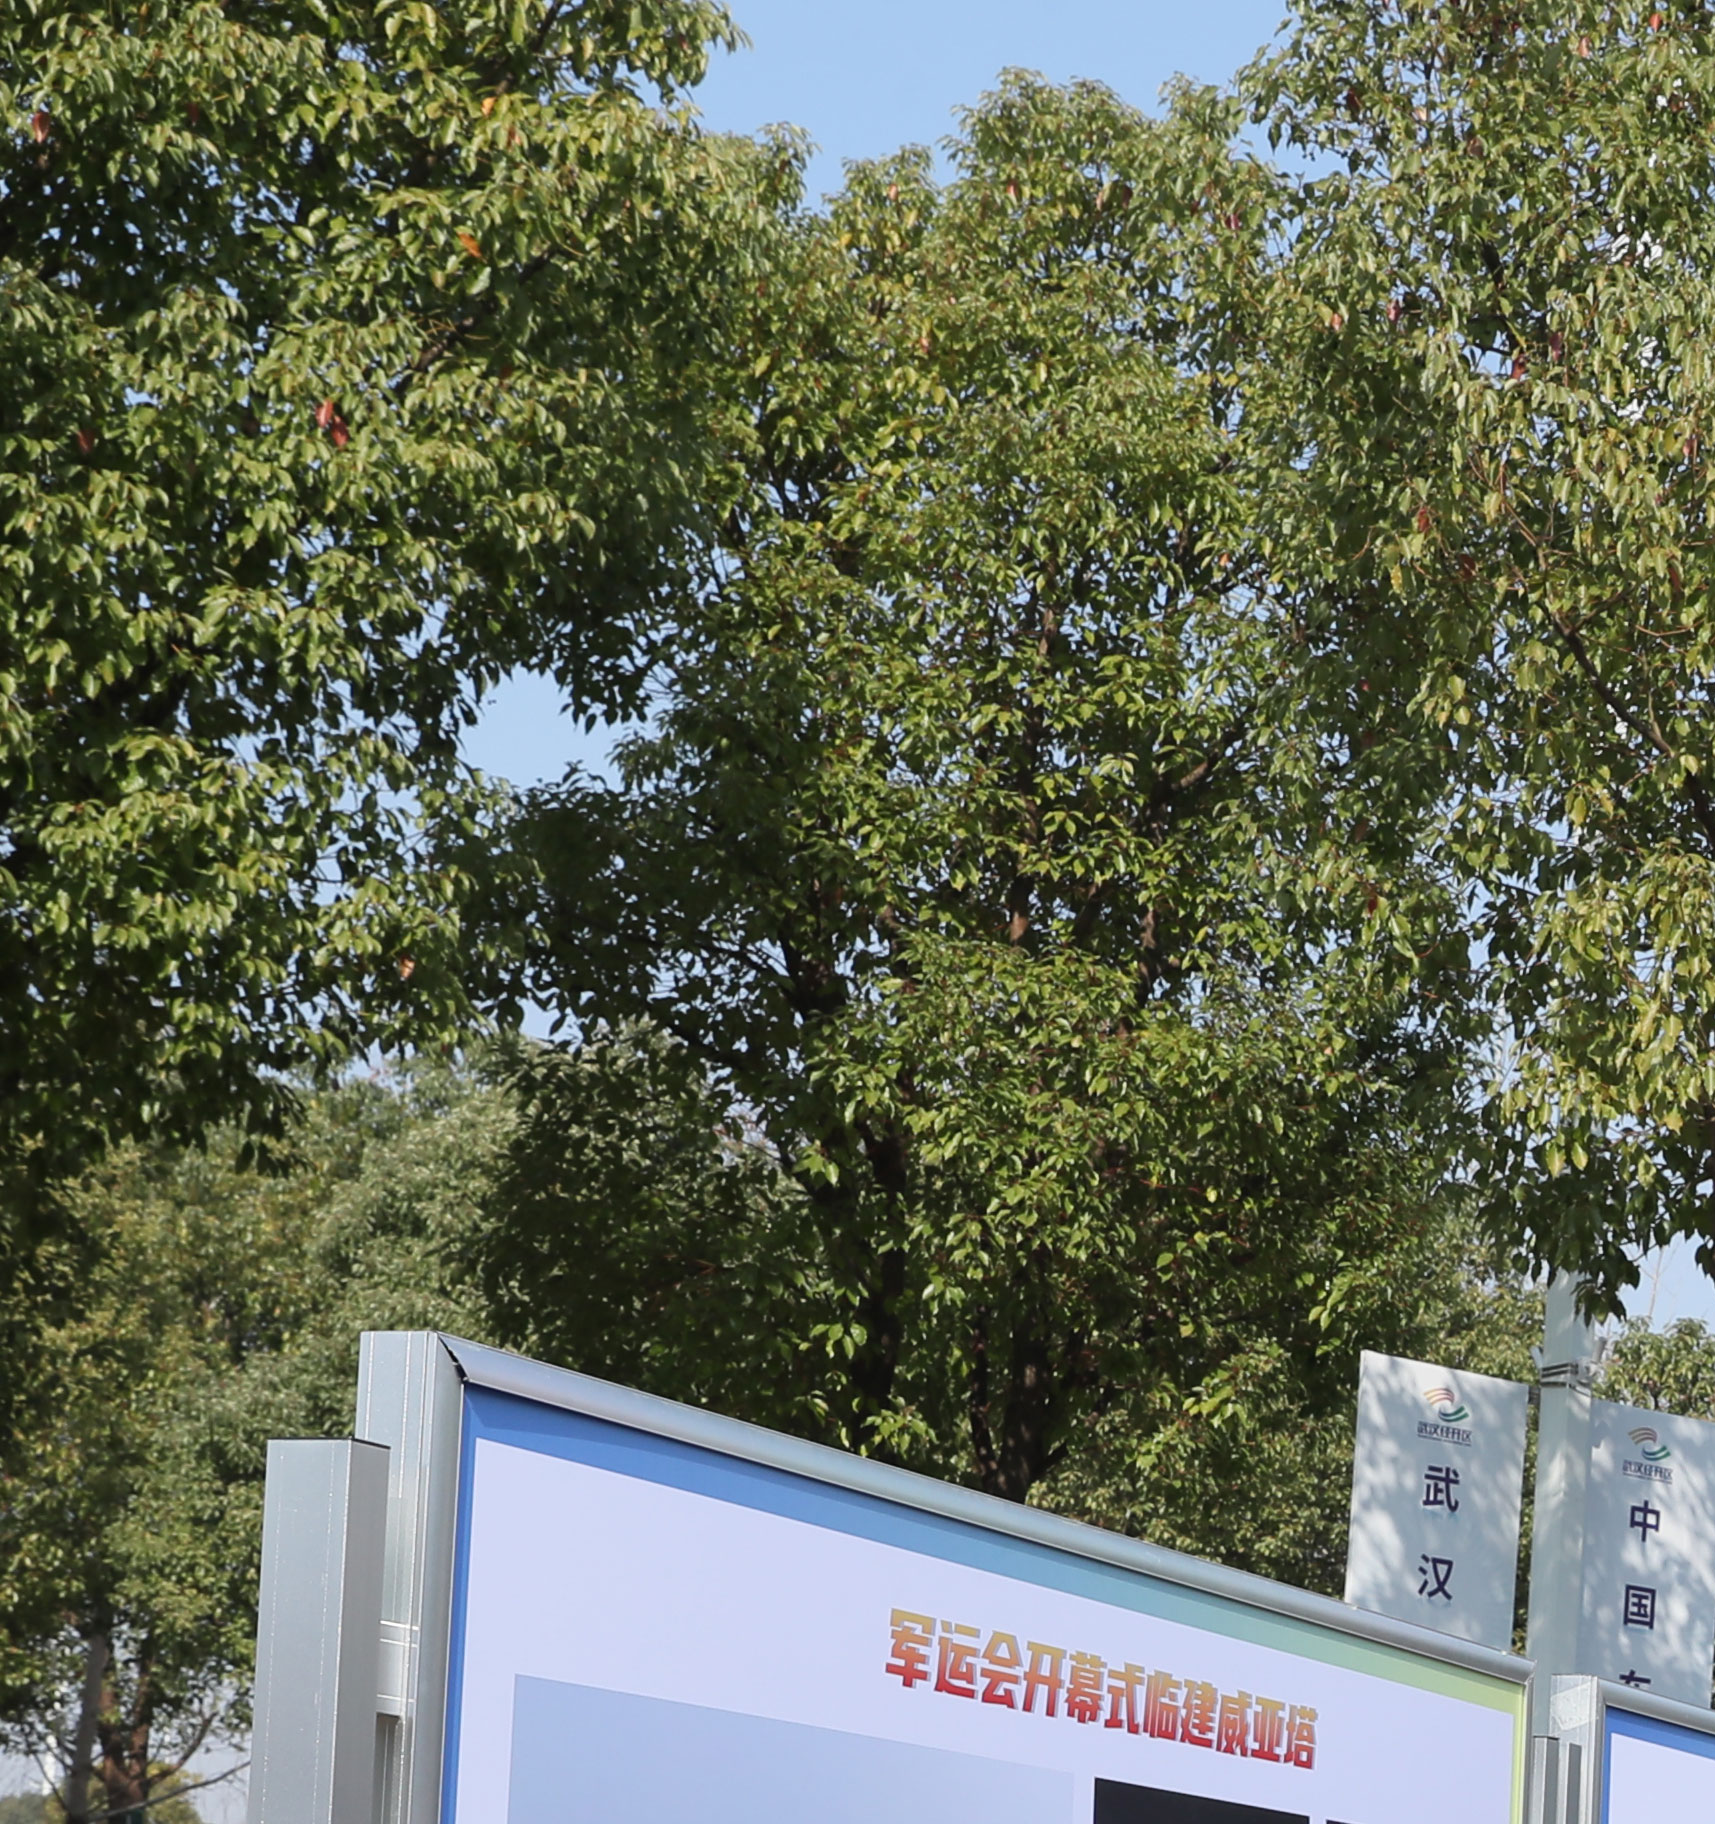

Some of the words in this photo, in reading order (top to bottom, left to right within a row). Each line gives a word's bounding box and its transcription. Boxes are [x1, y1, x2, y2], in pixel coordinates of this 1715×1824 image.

[1417, 1464, 1461, 1601] 武汉
[885, 1607, 1319, 1770] 军运会开幕式临建威亚塔
